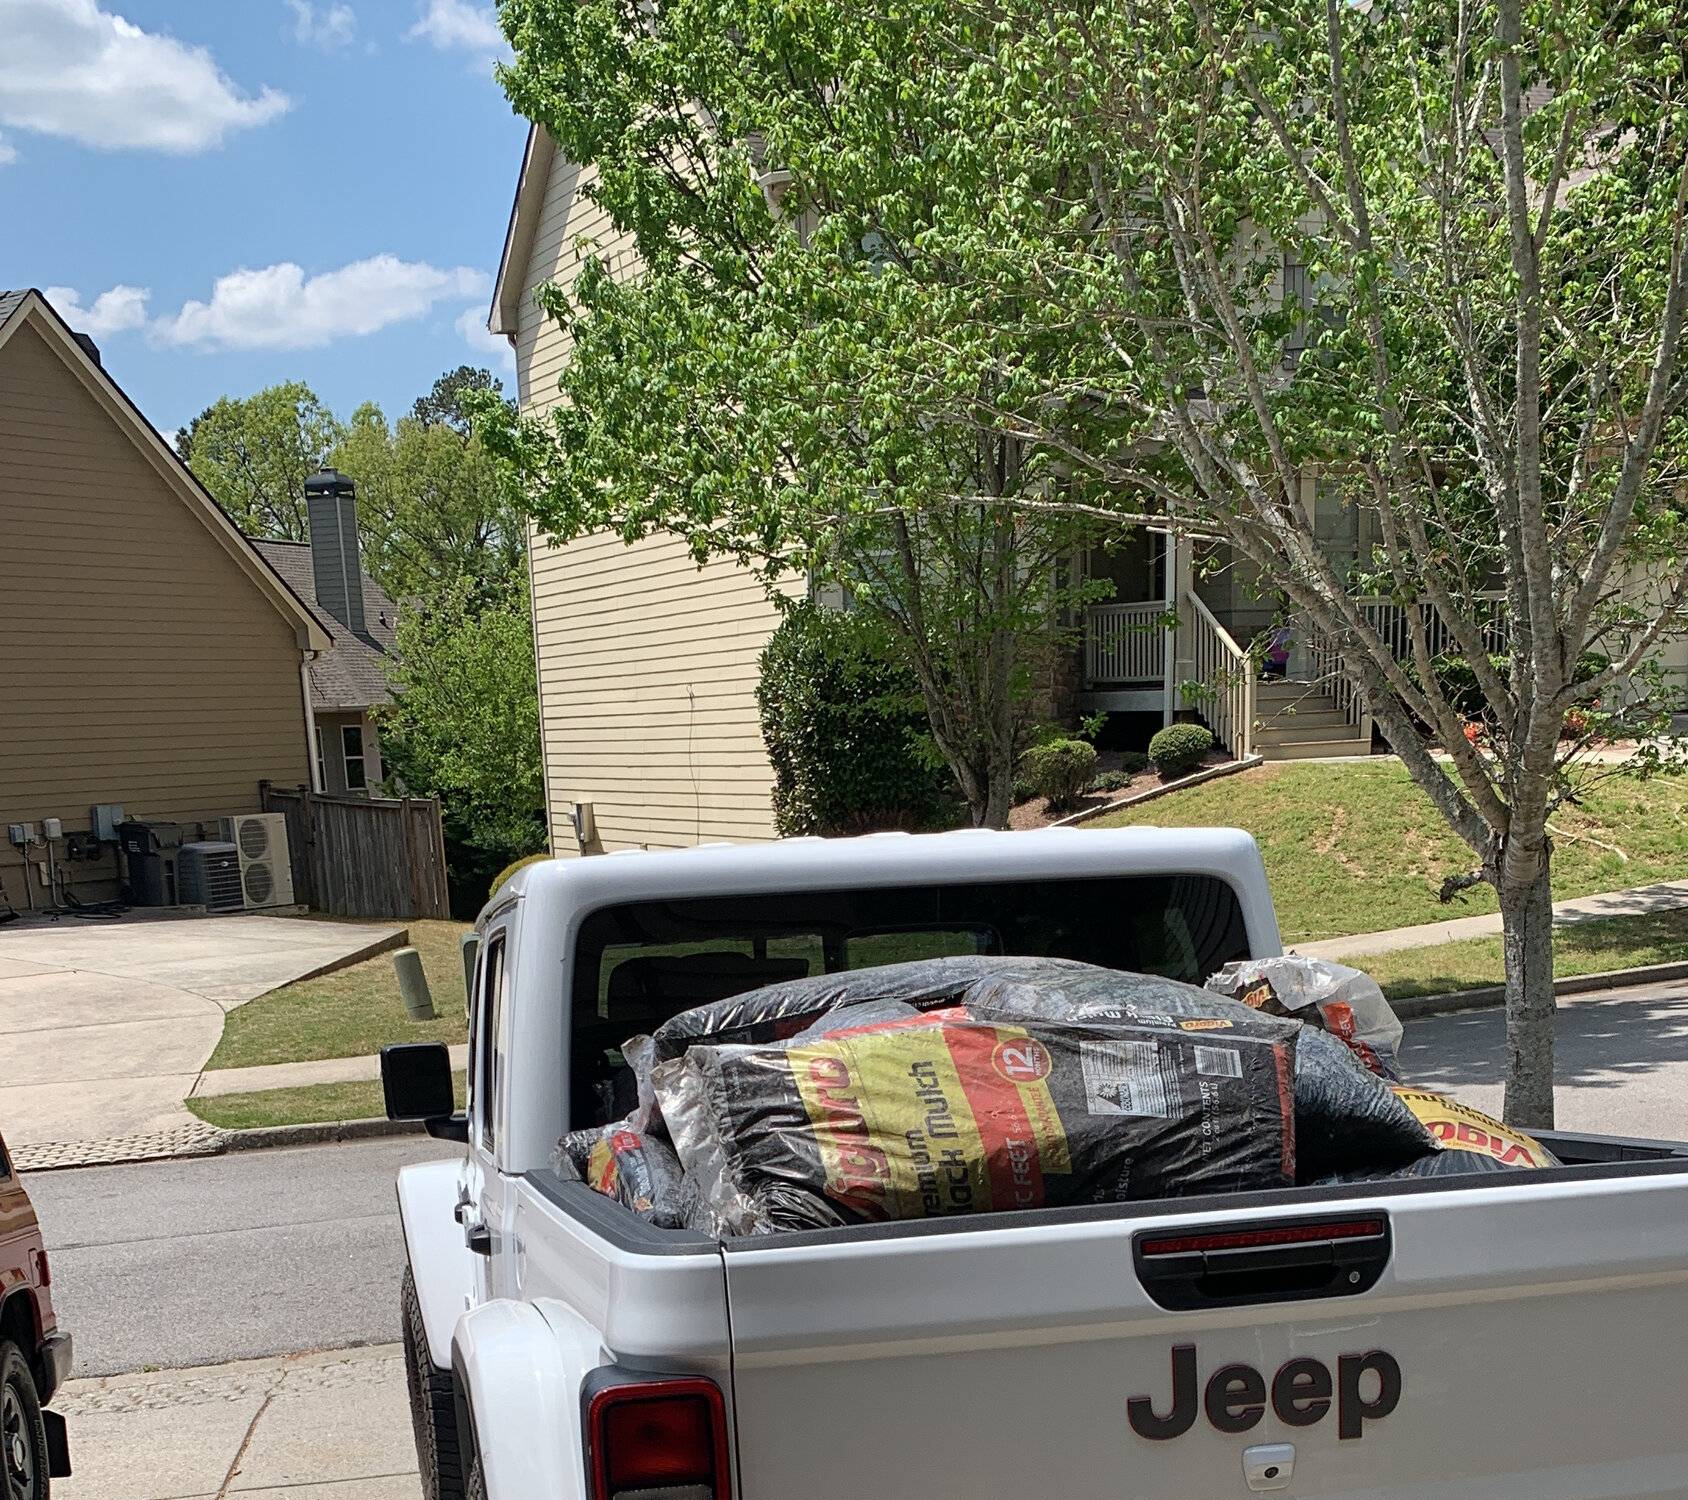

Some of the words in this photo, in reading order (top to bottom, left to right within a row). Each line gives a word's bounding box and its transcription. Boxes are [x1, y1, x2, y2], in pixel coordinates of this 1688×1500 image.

[1183, 1020, 1229, 1030] Vigoro
[1003, 1046, 1035, 1075] 12
[1033, 1046, 1042, 1077] MONTHS
[908, 1061, 959, 1138] Mulch
[1198, 1081, 1212, 1136] CONTENTS
[1425, 1120, 1536, 1169] Vigo
[905, 1130, 941, 1218] remium
[938, 1149, 973, 1214] lack
[1115, 1157, 1134, 1202] oisture
[1127, 1343, 1402, 1441] Jeep
